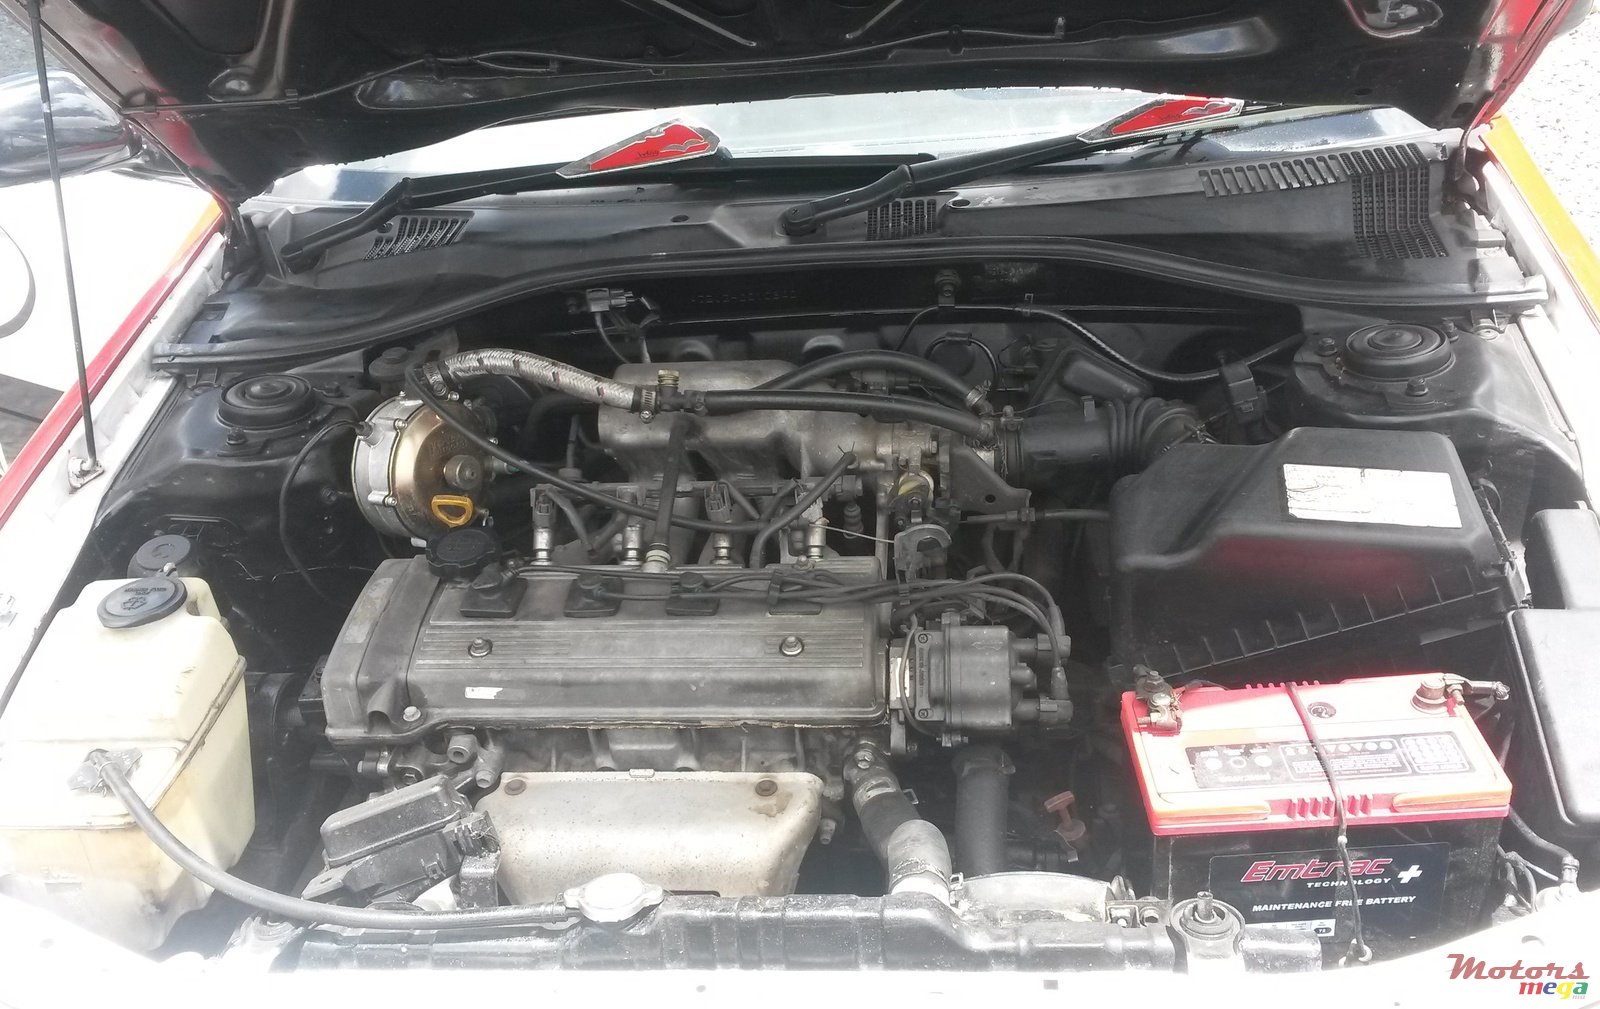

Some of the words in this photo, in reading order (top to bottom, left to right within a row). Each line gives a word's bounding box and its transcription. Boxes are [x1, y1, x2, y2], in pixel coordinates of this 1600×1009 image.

[1241, 858, 1393, 882] Emtrac
[1252, 901, 1332, 912] MAINTENANCE
[1365, 895, 1416, 905] BATTERY
